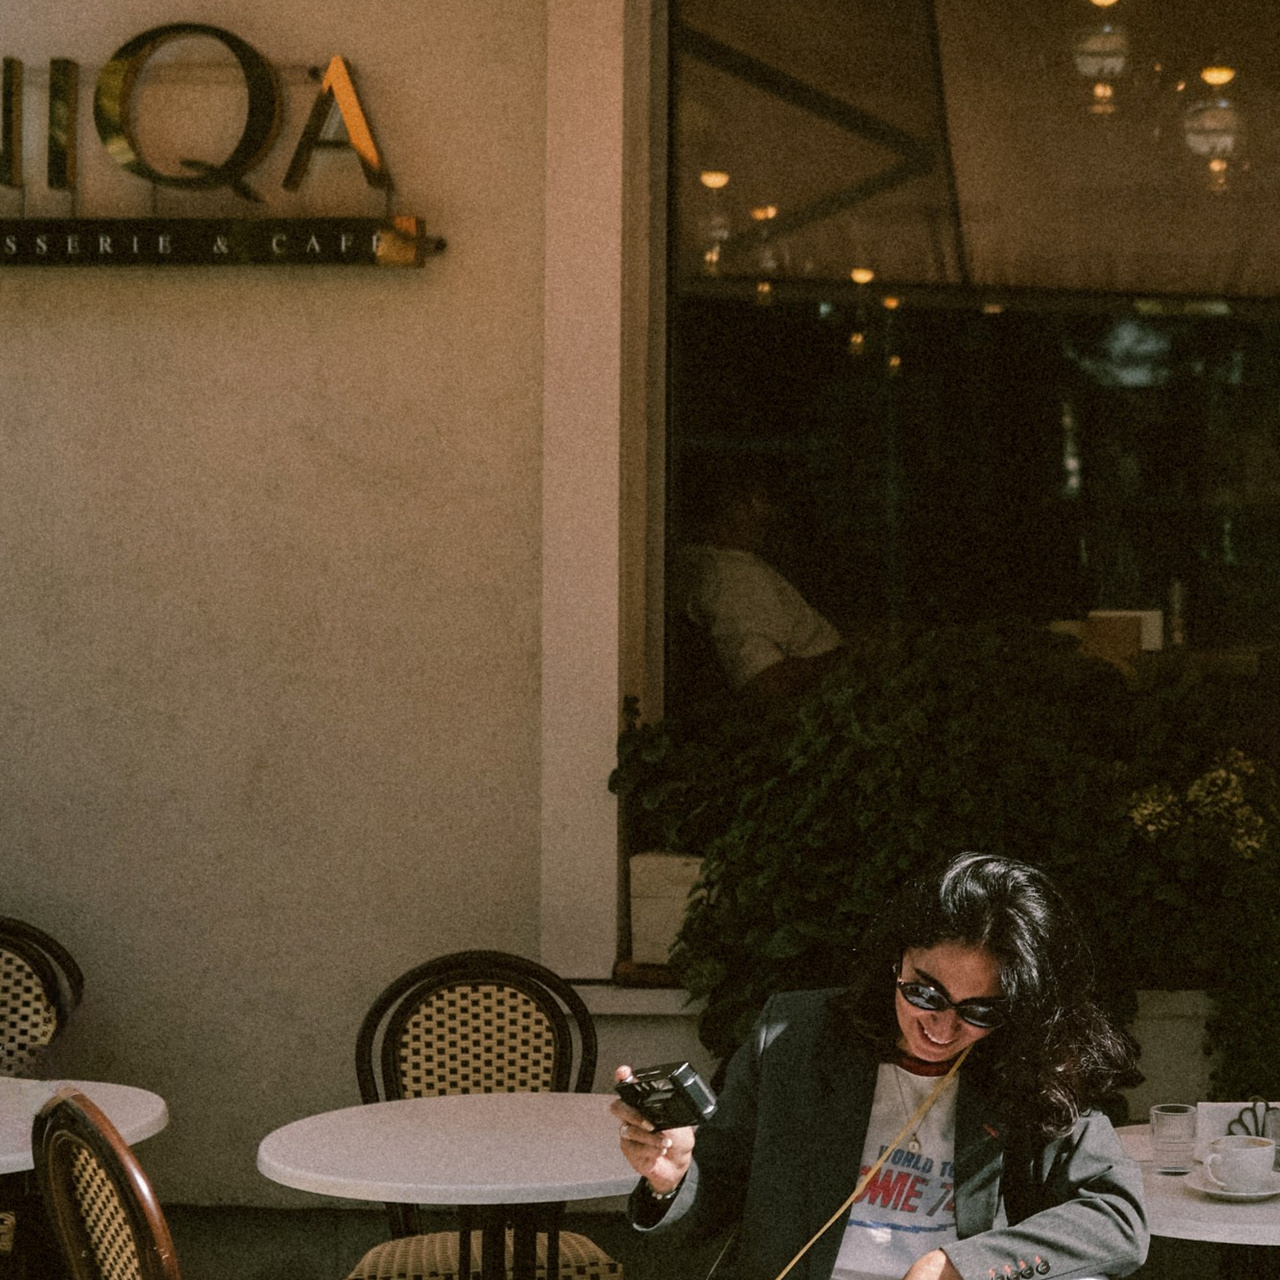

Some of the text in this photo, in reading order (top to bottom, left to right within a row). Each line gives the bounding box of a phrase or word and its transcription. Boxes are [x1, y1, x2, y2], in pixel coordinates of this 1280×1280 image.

[0, 22, 392, 202] IQA
[213, 234, 229, 254] &
[878, 1145, 934, 1174] WORLD
